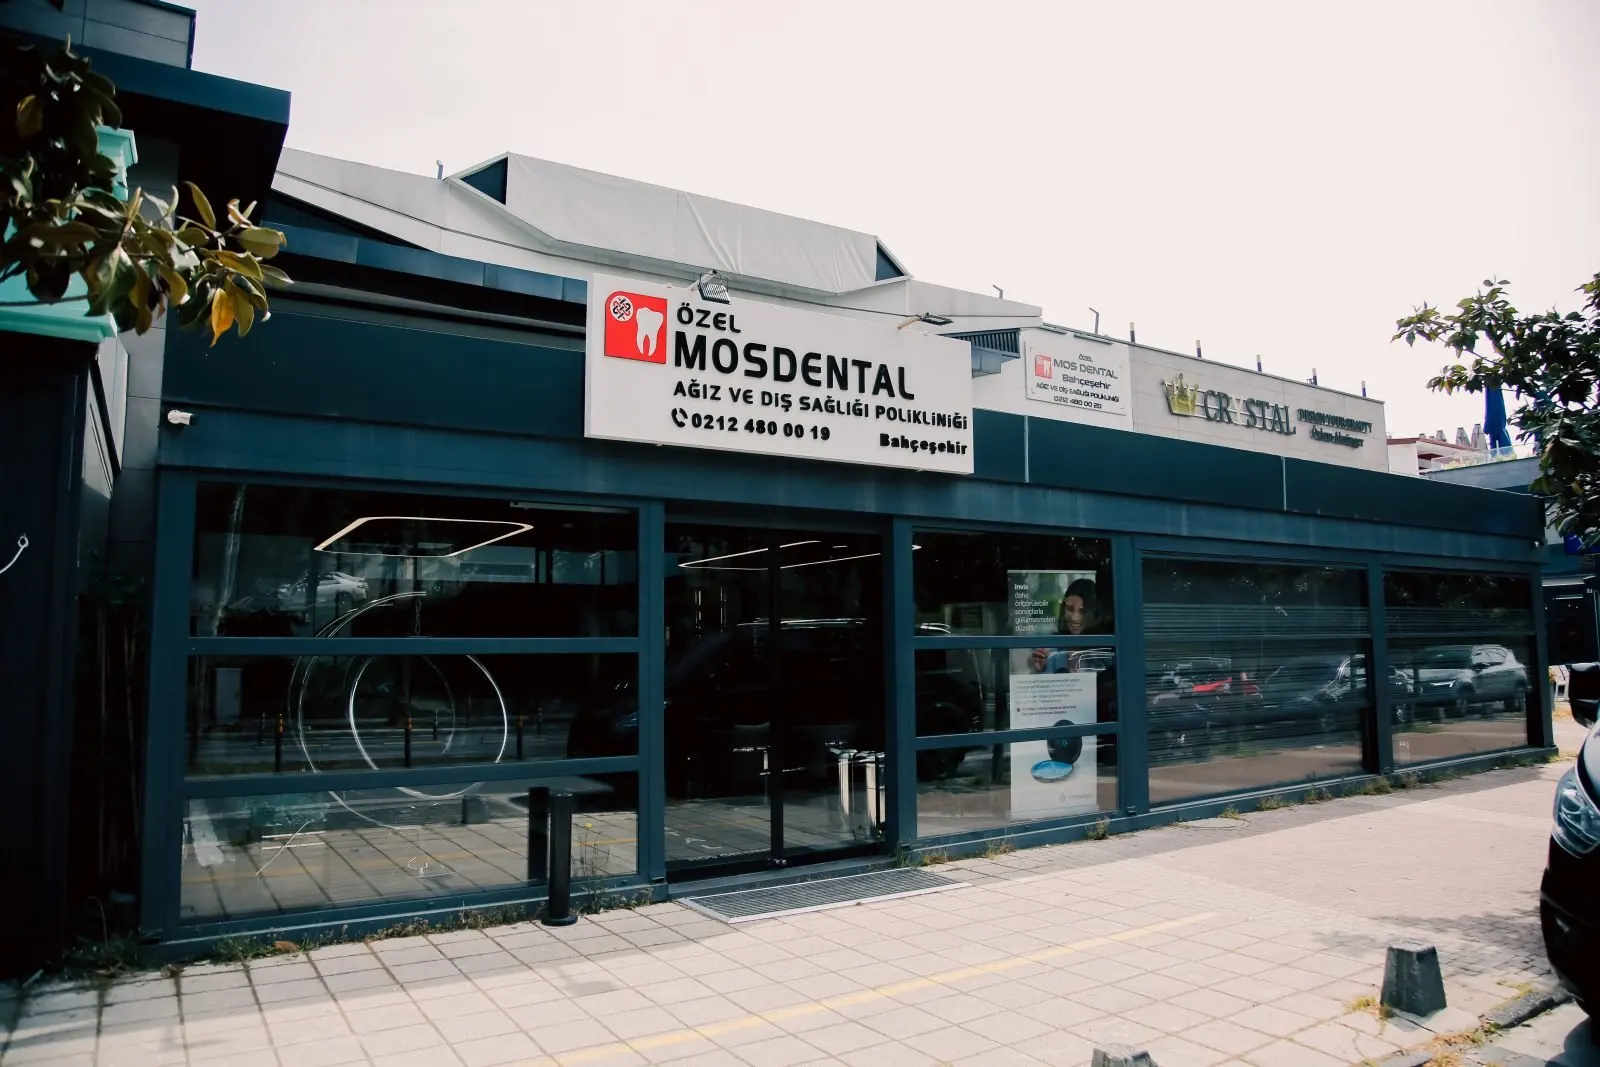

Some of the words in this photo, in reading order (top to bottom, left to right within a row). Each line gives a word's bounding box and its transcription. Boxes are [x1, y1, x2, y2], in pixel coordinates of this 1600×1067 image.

[676, 302, 741, 334] ÖZEL
[674, 330, 915, 400] MOSDENTAL
[1053, 358, 1078, 371] MOS
[1079, 363, 1119, 380] DENTAL
[1078, 353, 1094, 363] ÖZEL
[1062, 373, 1112, 390] Bahçeşehir
[673, 379, 722, 401] AĞIZ
[729, 387, 754, 405] VE
[761, 391, 793, 412] DİŞ
[799, 395, 869, 418] SAĞLIĞI
[875, 405, 967, 430] POLİKLİNİĞİ
[1084, 400, 1093, 408] 00
[1203, 389, 1297, 436] CRYSTAL
[691, 413, 738, 431] 0212
[744, 419, 778, 436] 480
[783, 423, 805, 439] 00
[810, 425, 830, 440] 19
[879, 433, 968, 455] Bahçeşehir
